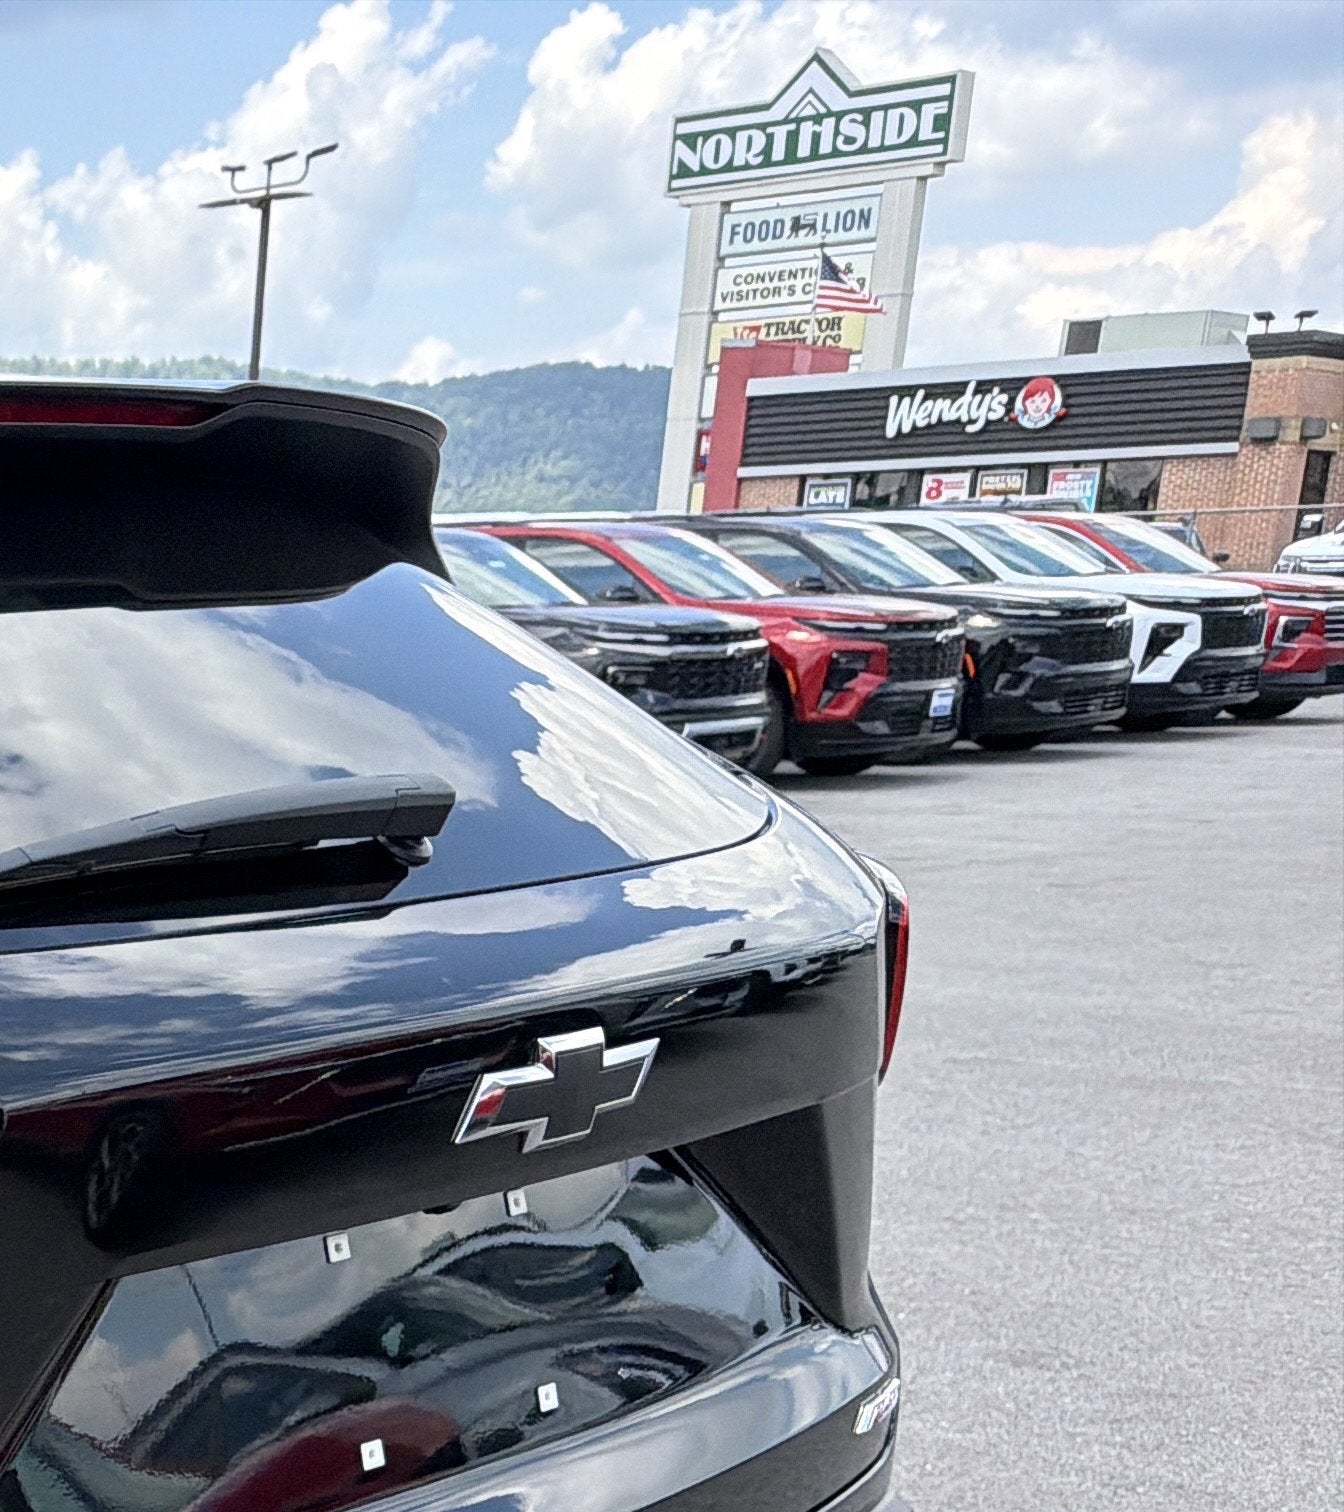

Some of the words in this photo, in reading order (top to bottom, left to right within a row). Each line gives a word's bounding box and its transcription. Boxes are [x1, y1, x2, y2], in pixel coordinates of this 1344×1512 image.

[672, 101, 949, 175] NORTHSIDE
[728, 220, 785, 246] FOOD
[820, 207, 872, 236] LION
[732, 266, 820, 287] CONVENTI
[720, 283, 797, 304] VISITOR'S
[763, 315, 845, 338] TRACOR
[885, 380, 1009, 439] Wendy's
